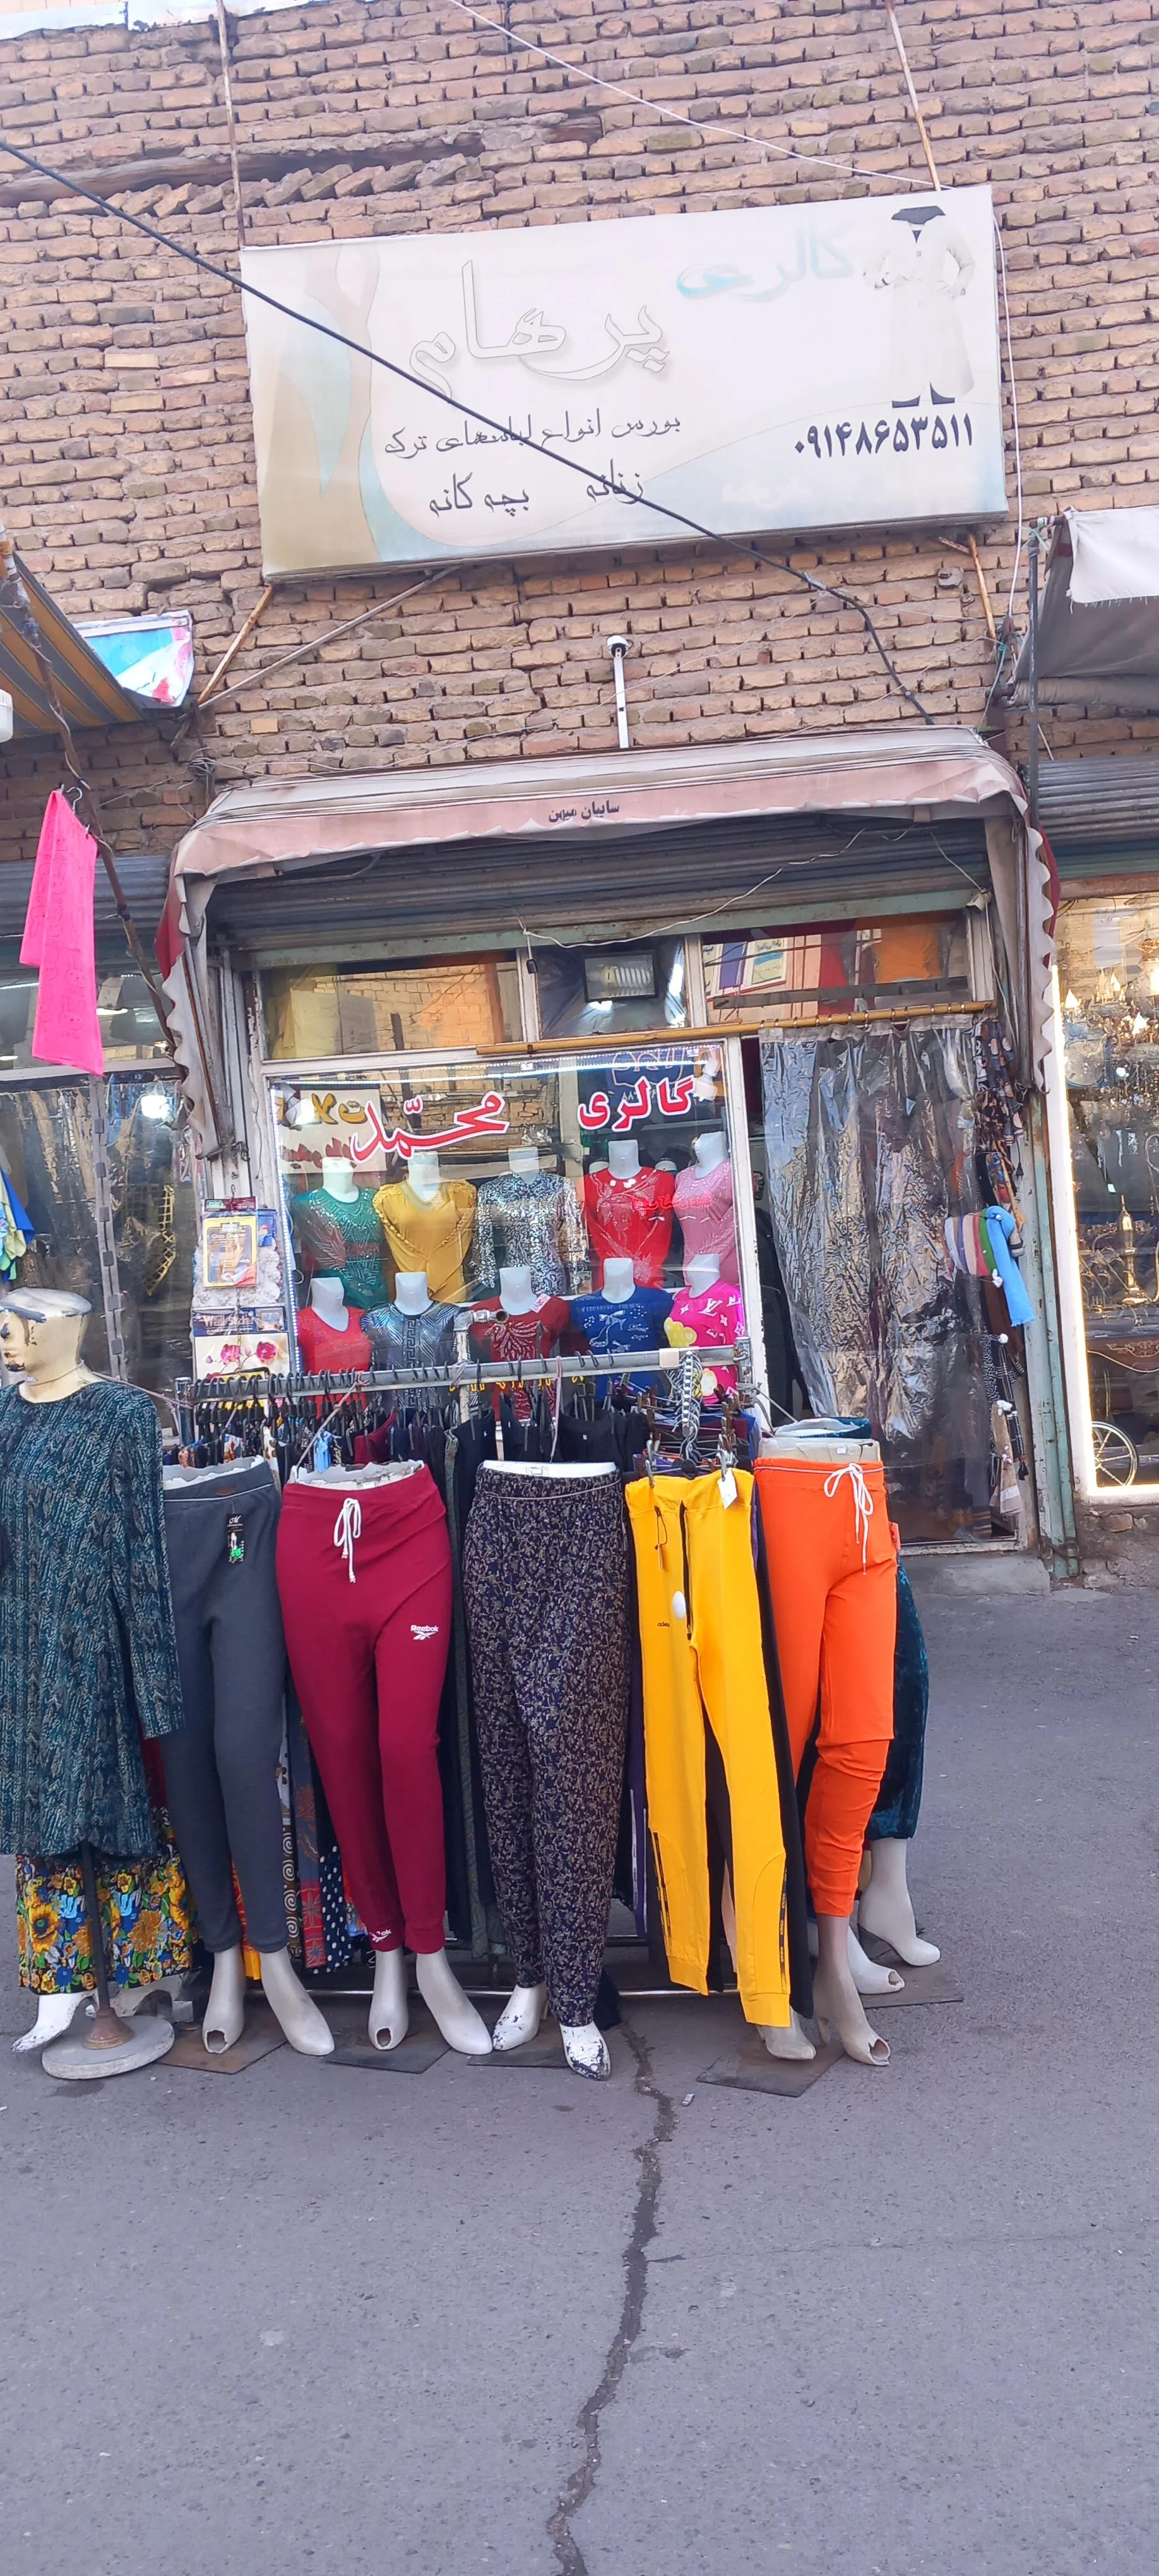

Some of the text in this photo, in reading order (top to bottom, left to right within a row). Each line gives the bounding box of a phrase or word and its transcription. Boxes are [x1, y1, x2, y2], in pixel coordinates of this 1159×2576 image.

[409, 259, 670, 402] پرهام
[384, 426, 427, 459] ترک
[542, 408, 601, 446] انواع
[612, 417, 681, 438] بورس
[793, 412, 973, 459] ۰۹۱۴۸۶۵۳۵۱۱
[586, 458, 644, 504] زنانه
[484, 489, 530, 517] بچه
[548, 799, 620, 823] سایبان میهن
[577, 1075, 696, 1132] گالری
